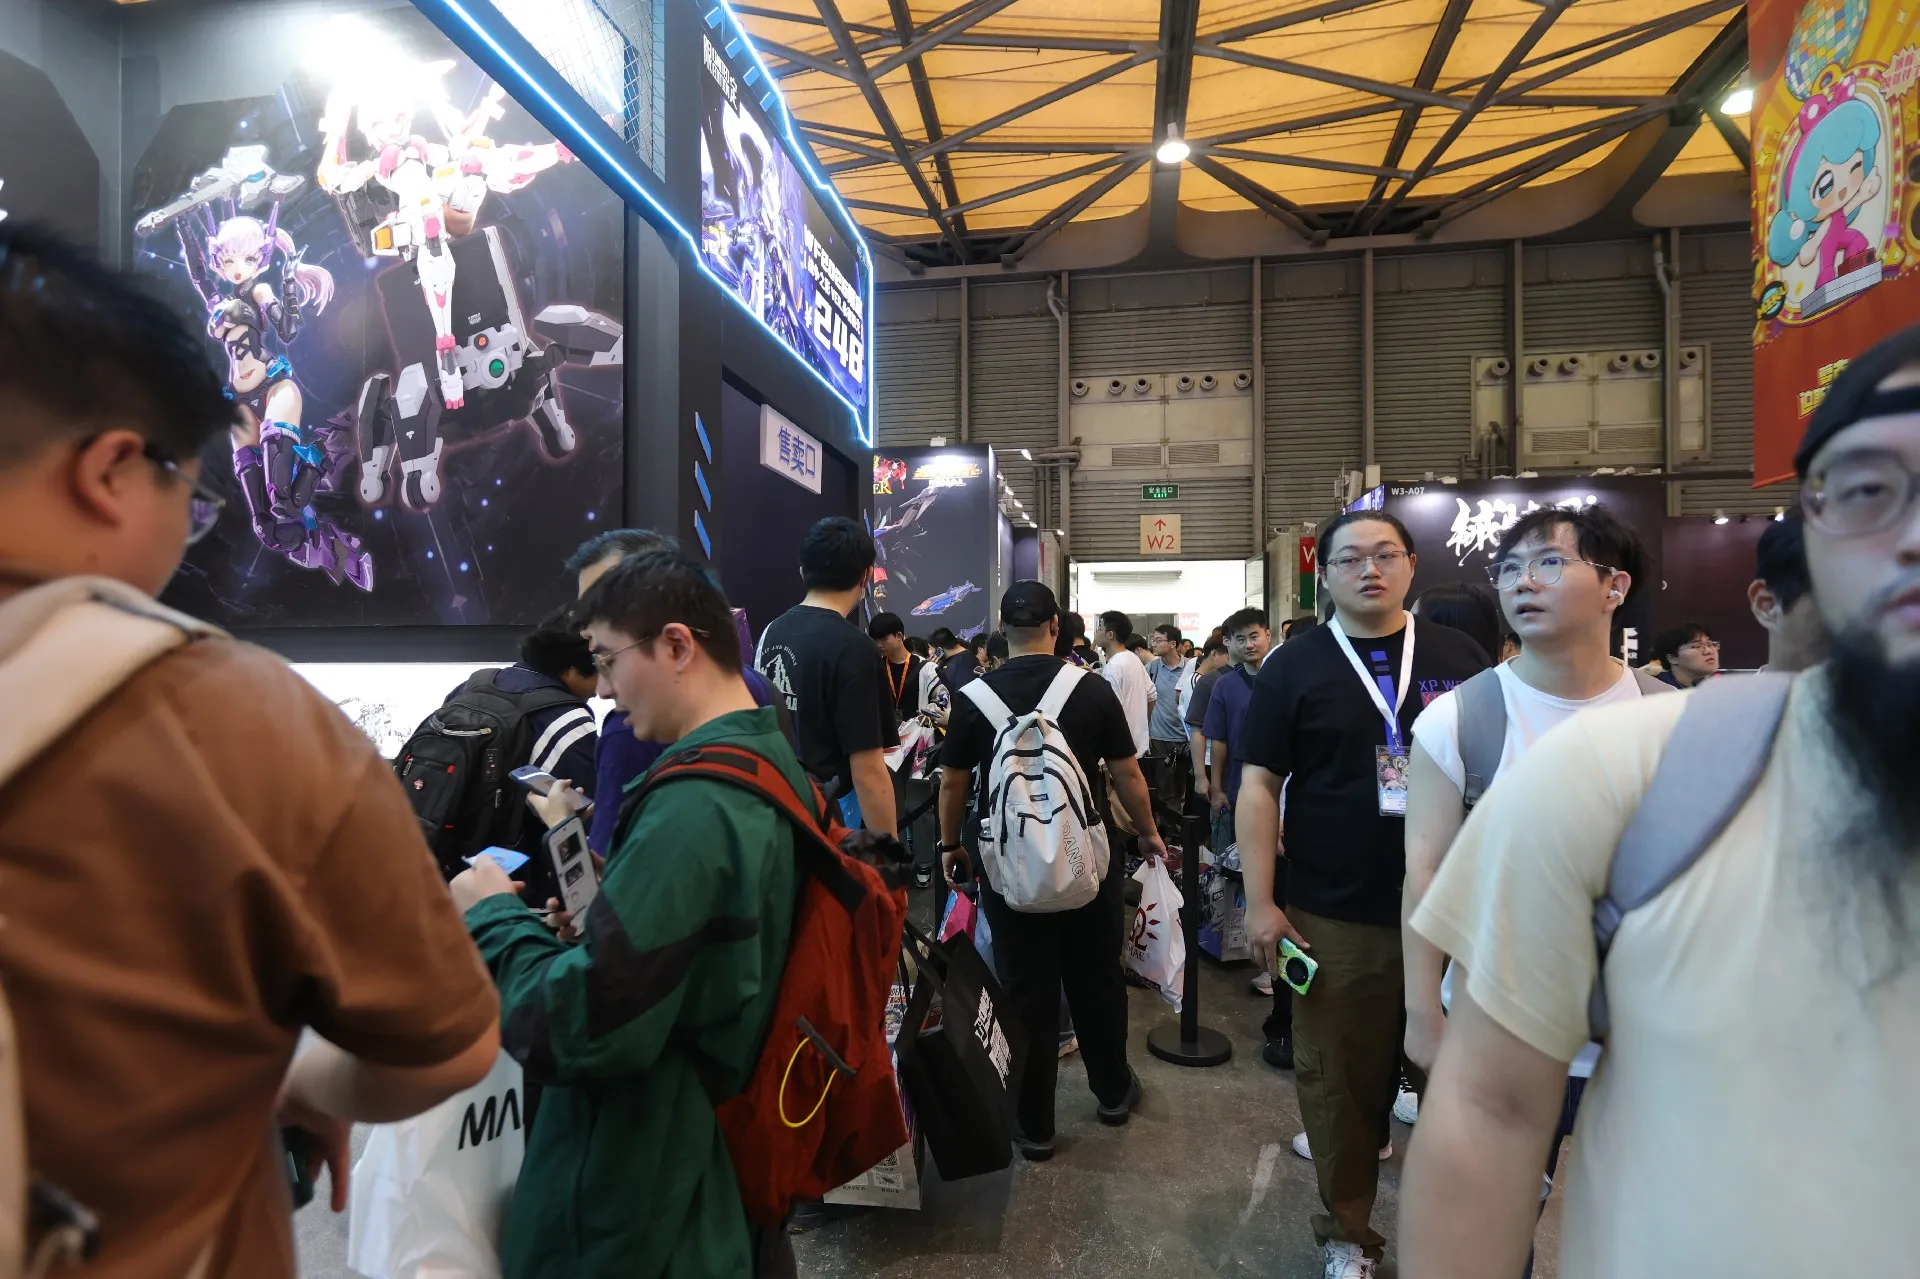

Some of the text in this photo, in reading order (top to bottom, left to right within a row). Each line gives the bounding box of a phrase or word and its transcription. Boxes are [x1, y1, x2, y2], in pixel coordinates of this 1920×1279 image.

[712, 47, 730, 84] LIMITED
[777, 426, 816, 479] 售卖口
[1391, 487, 1425, 496] W3-A07
[1147, 534, 1175, 551] W2
[1418, 679, 1438, 692] XP
